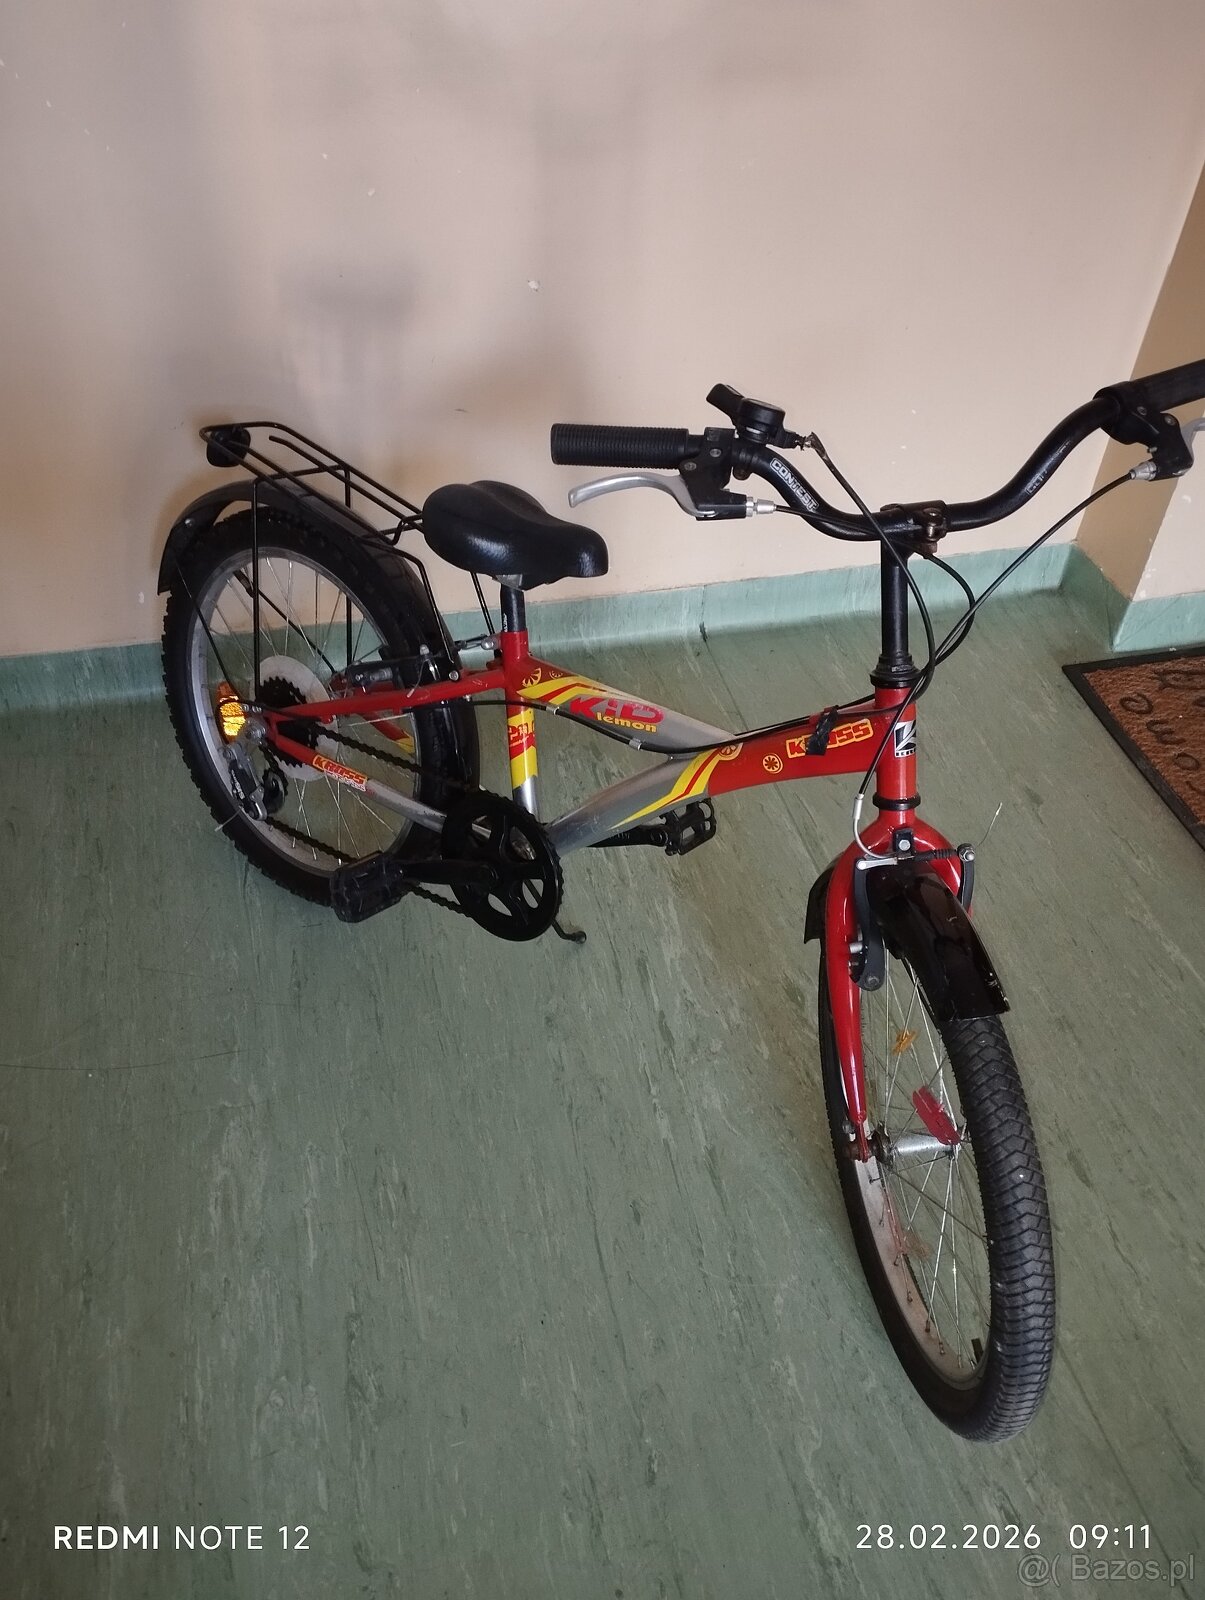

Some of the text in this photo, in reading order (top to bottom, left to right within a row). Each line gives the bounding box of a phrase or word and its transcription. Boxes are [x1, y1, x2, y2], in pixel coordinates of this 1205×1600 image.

[771, 459, 818, 511] CONTEST
[596, 712, 657, 733] lemon
[314, 757, 367, 785] KROSS
